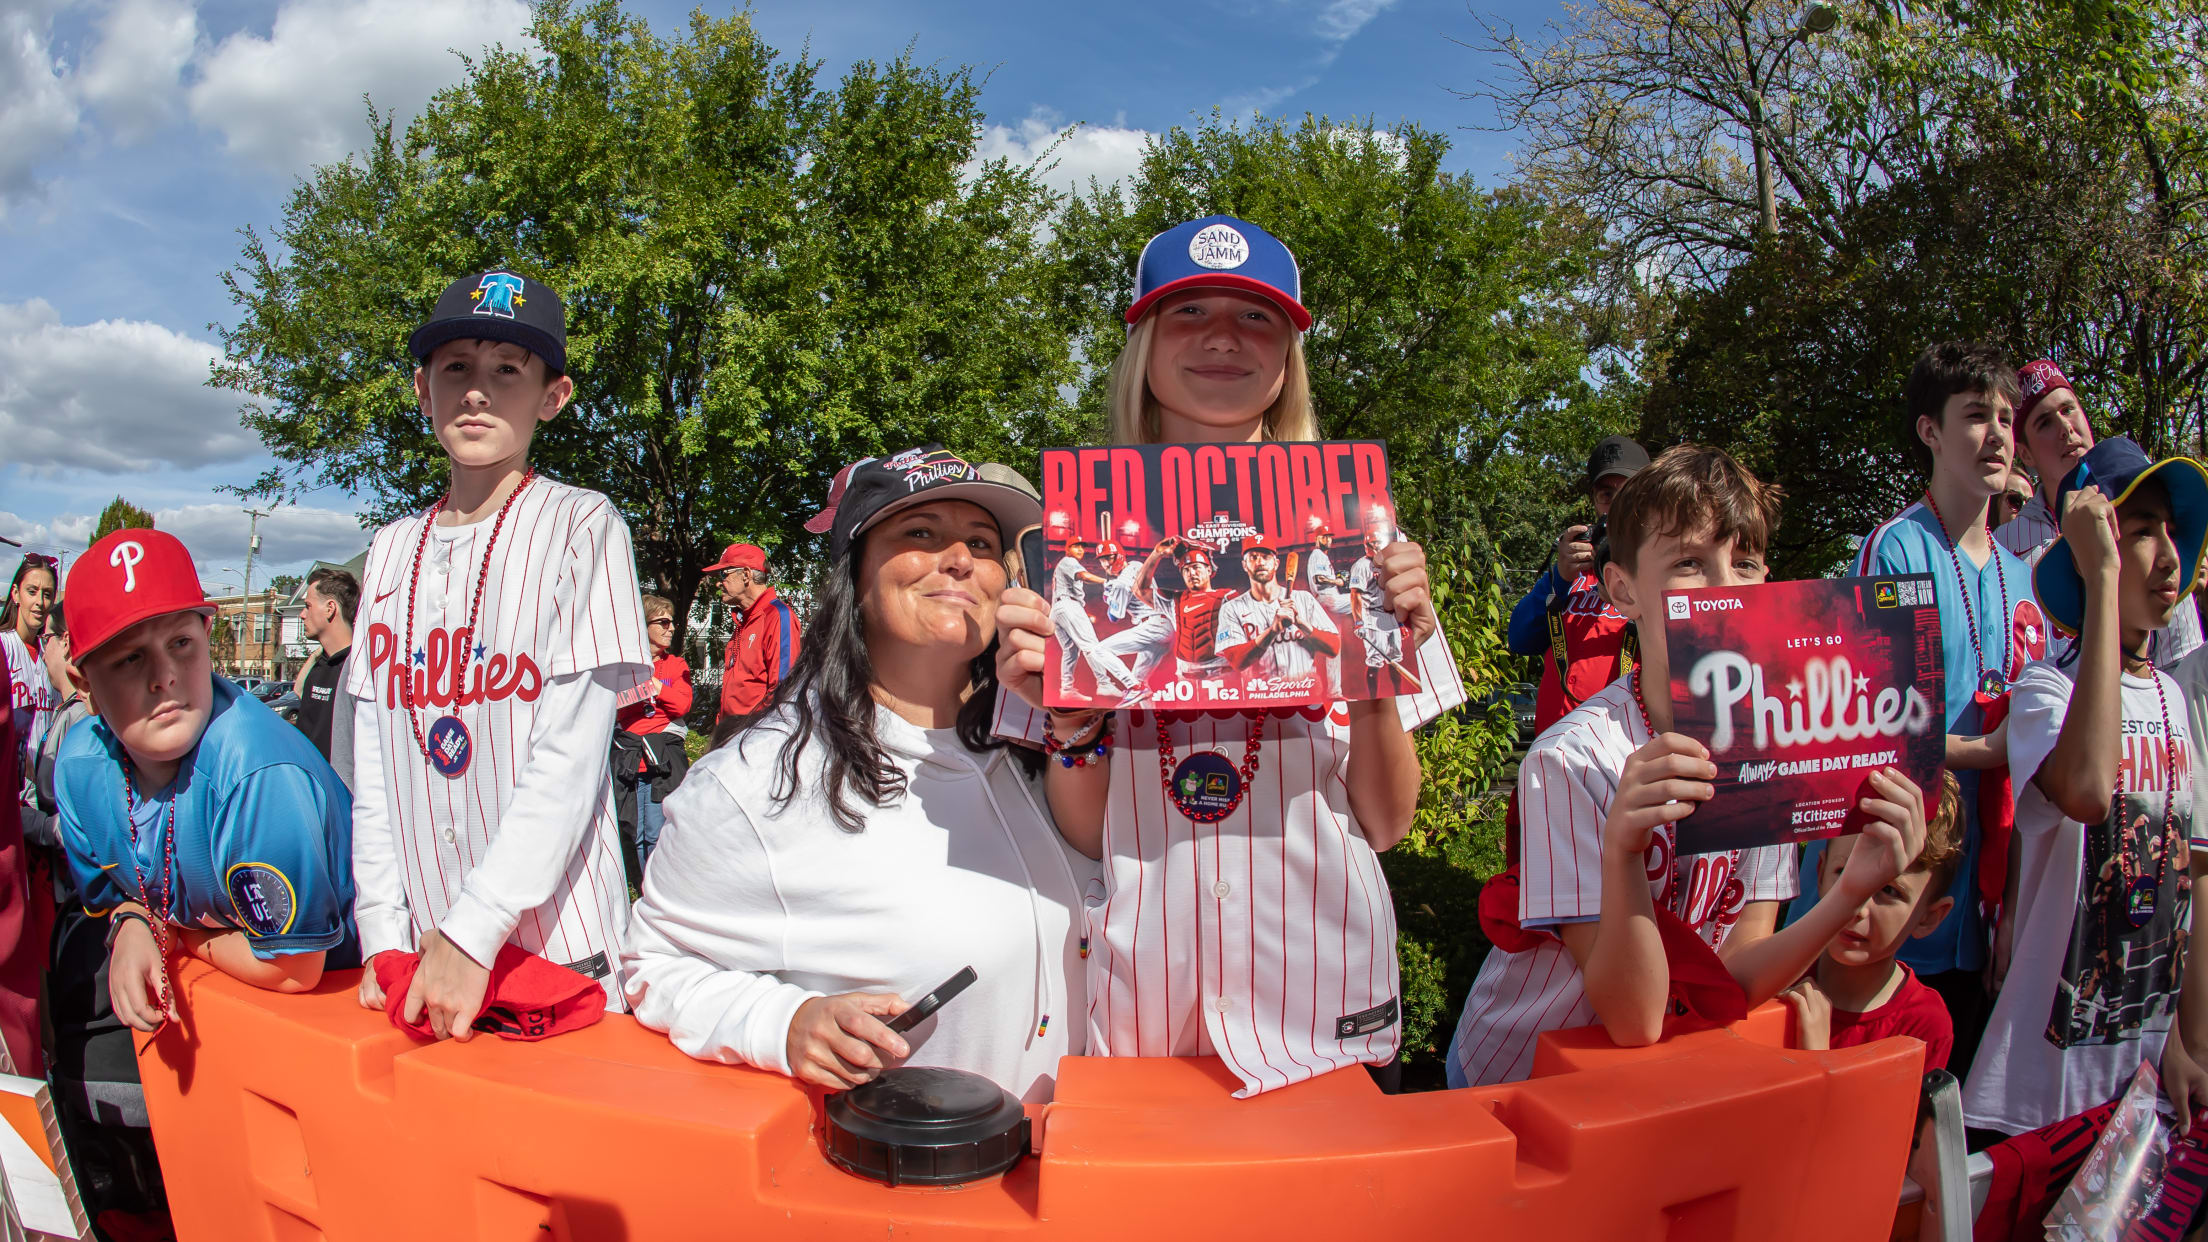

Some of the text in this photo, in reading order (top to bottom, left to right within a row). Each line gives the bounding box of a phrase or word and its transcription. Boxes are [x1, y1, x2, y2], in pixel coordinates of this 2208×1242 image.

[1198, 231, 1240, 244] SAND
[1197, 247, 1241, 262] JAMM
[903, 463, 962, 492] Phillies
[1043, 444, 1396, 544] RED OCTOBER
[1187, 526, 1257, 539] CHAMPIONS
[1216, 537, 1230, 554] P
[109, 540, 145, 593] P
[1693, 599, 1743, 611] TOYOTA
[1918, 588, 1934, 605] NOW
[1787, 635, 1842, 648] LET'S GO
[368, 623, 542, 710] Phillies
[1268, 677, 1314, 693] Sports
[1249, 690, 1310, 699] PHILADELPHIA
[1689, 650, 1932, 755] Phillies
[441, 728, 455, 749] GAME
[1778, 759, 1820, 776] GAME
[1822, 756, 1851, 771] DAY
[1851, 750, 1898, 768] READY.
[1804, 809, 1846, 822] Citizens
